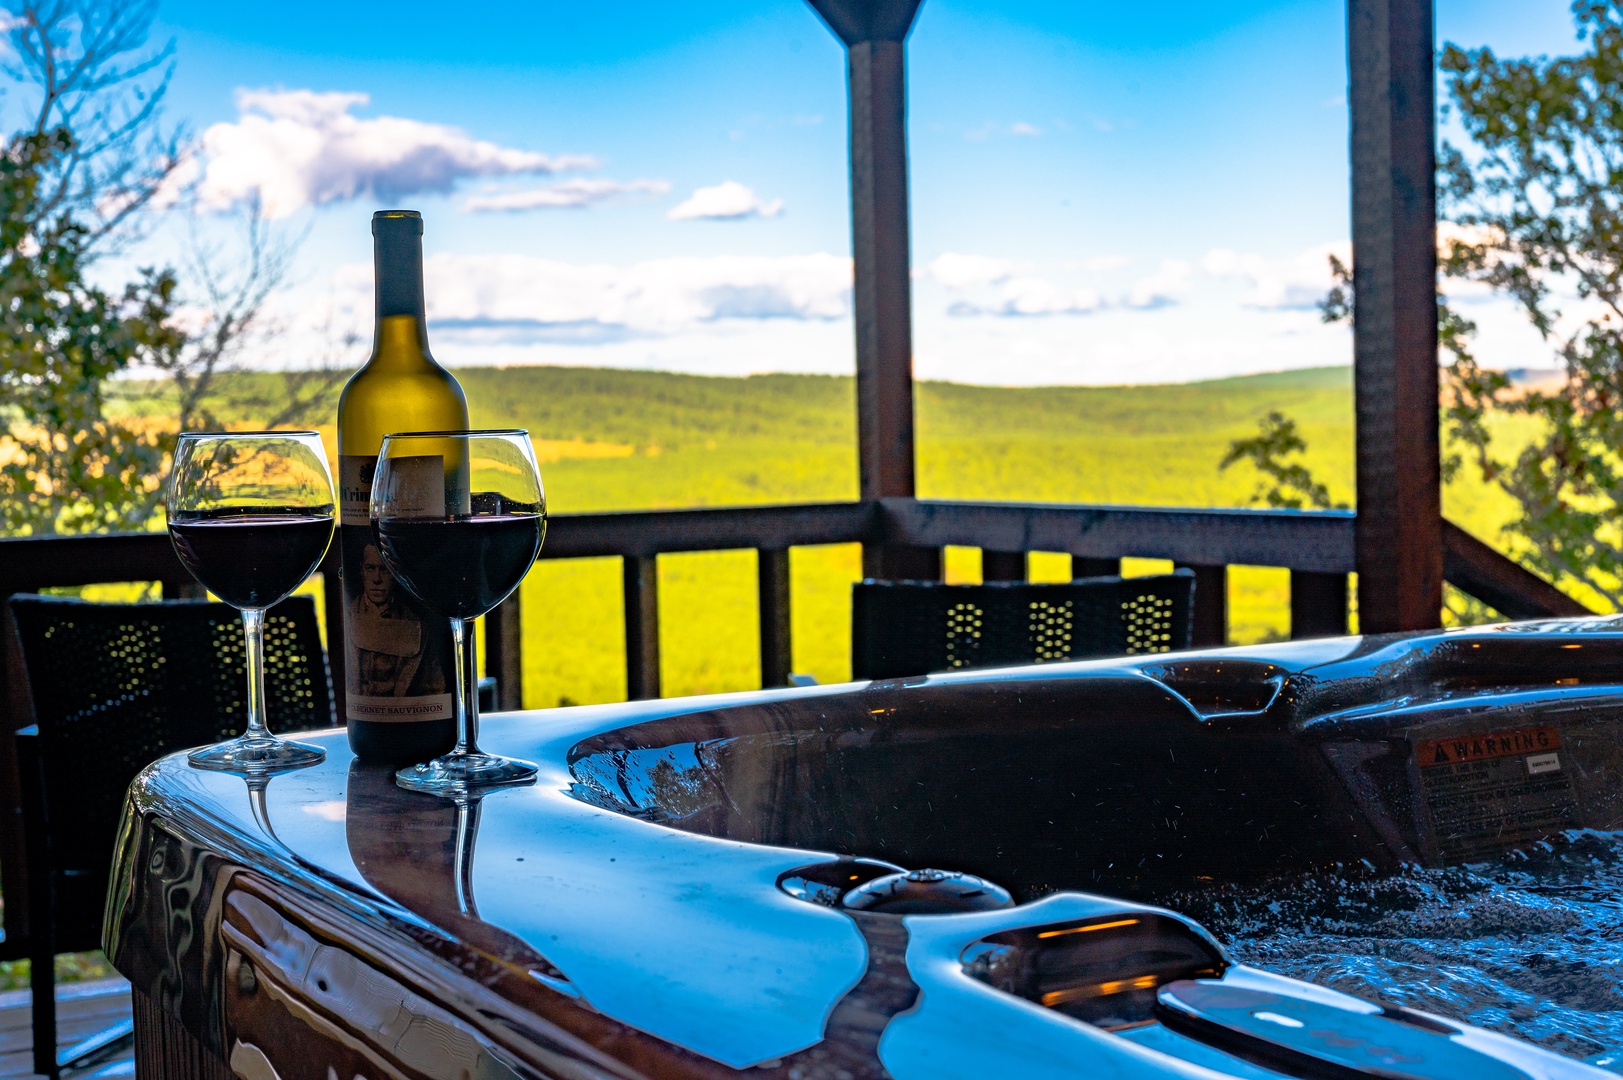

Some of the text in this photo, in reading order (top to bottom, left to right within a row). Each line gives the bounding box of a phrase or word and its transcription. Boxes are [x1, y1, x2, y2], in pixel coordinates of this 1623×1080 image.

[388, 704, 443, 714] SAUVIGNON
[1453, 732, 1549, 758] WARNING
[1456, 763, 1470, 773] THE
